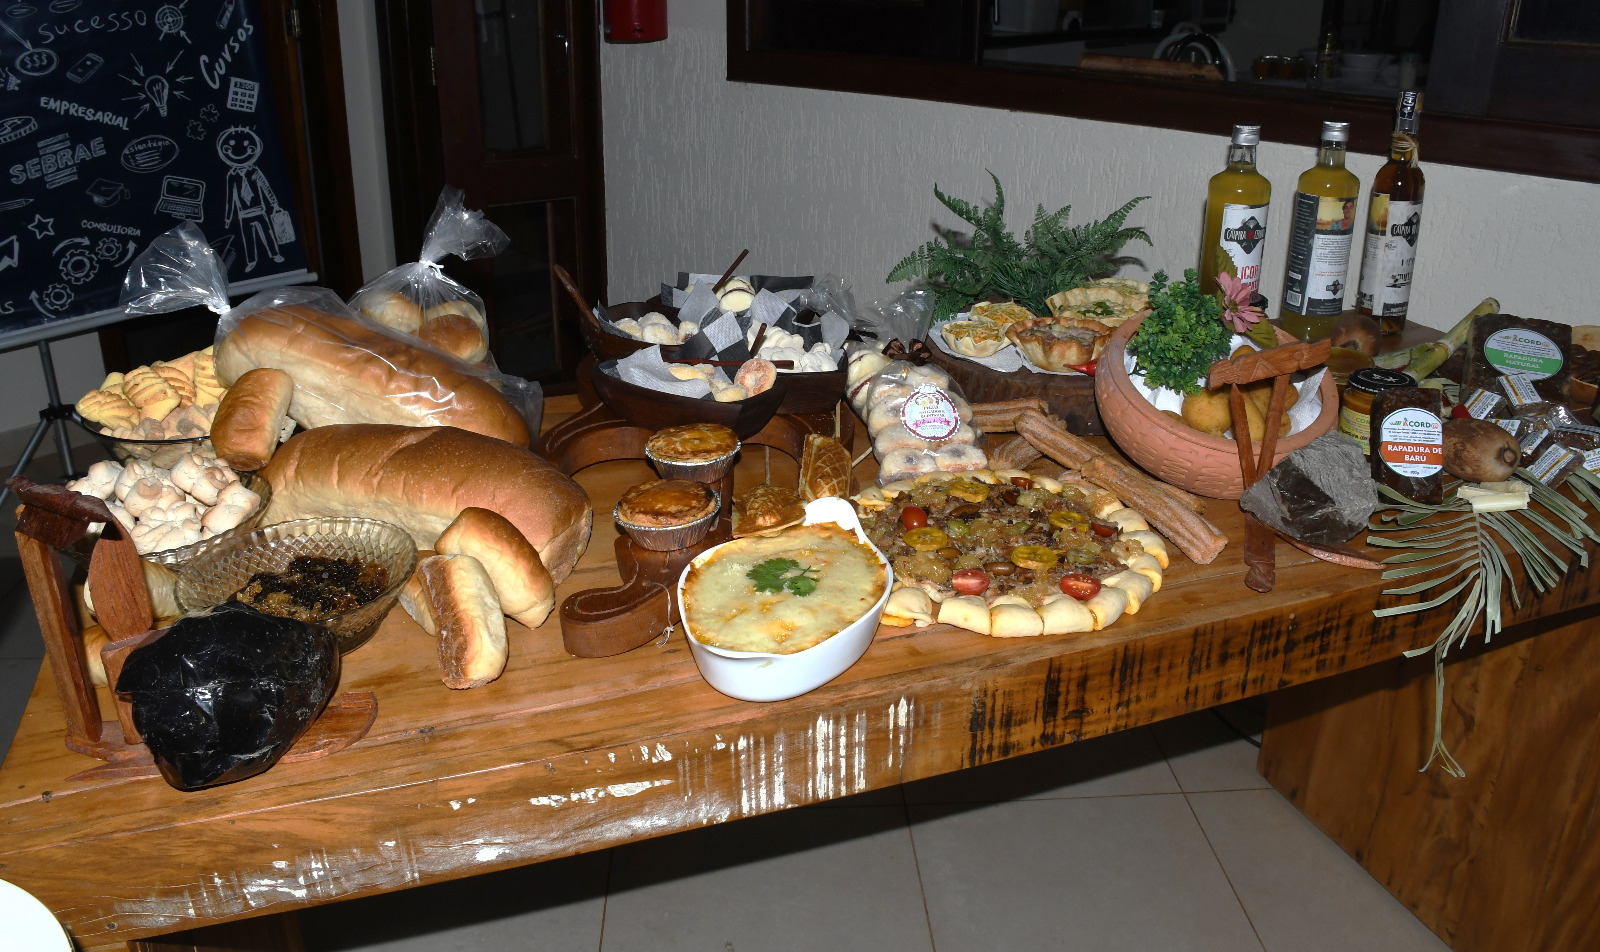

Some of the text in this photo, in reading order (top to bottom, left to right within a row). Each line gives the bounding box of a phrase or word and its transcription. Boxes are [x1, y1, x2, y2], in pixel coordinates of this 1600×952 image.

[200, 18, 254, 90] Cursos
[40, 96, 129, 131] EMPRESARIAL
[9, 137, 107, 184] SEBRAE
[81, 219, 141, 237] CONSULTORIA
[1503, 352, 1544, 364] RAPADURA
[1505, 360, 1541, 369] NATURAL
[1387, 444, 1431, 454] RAPADURA
[1404, 453, 1427, 462] BARÚ
